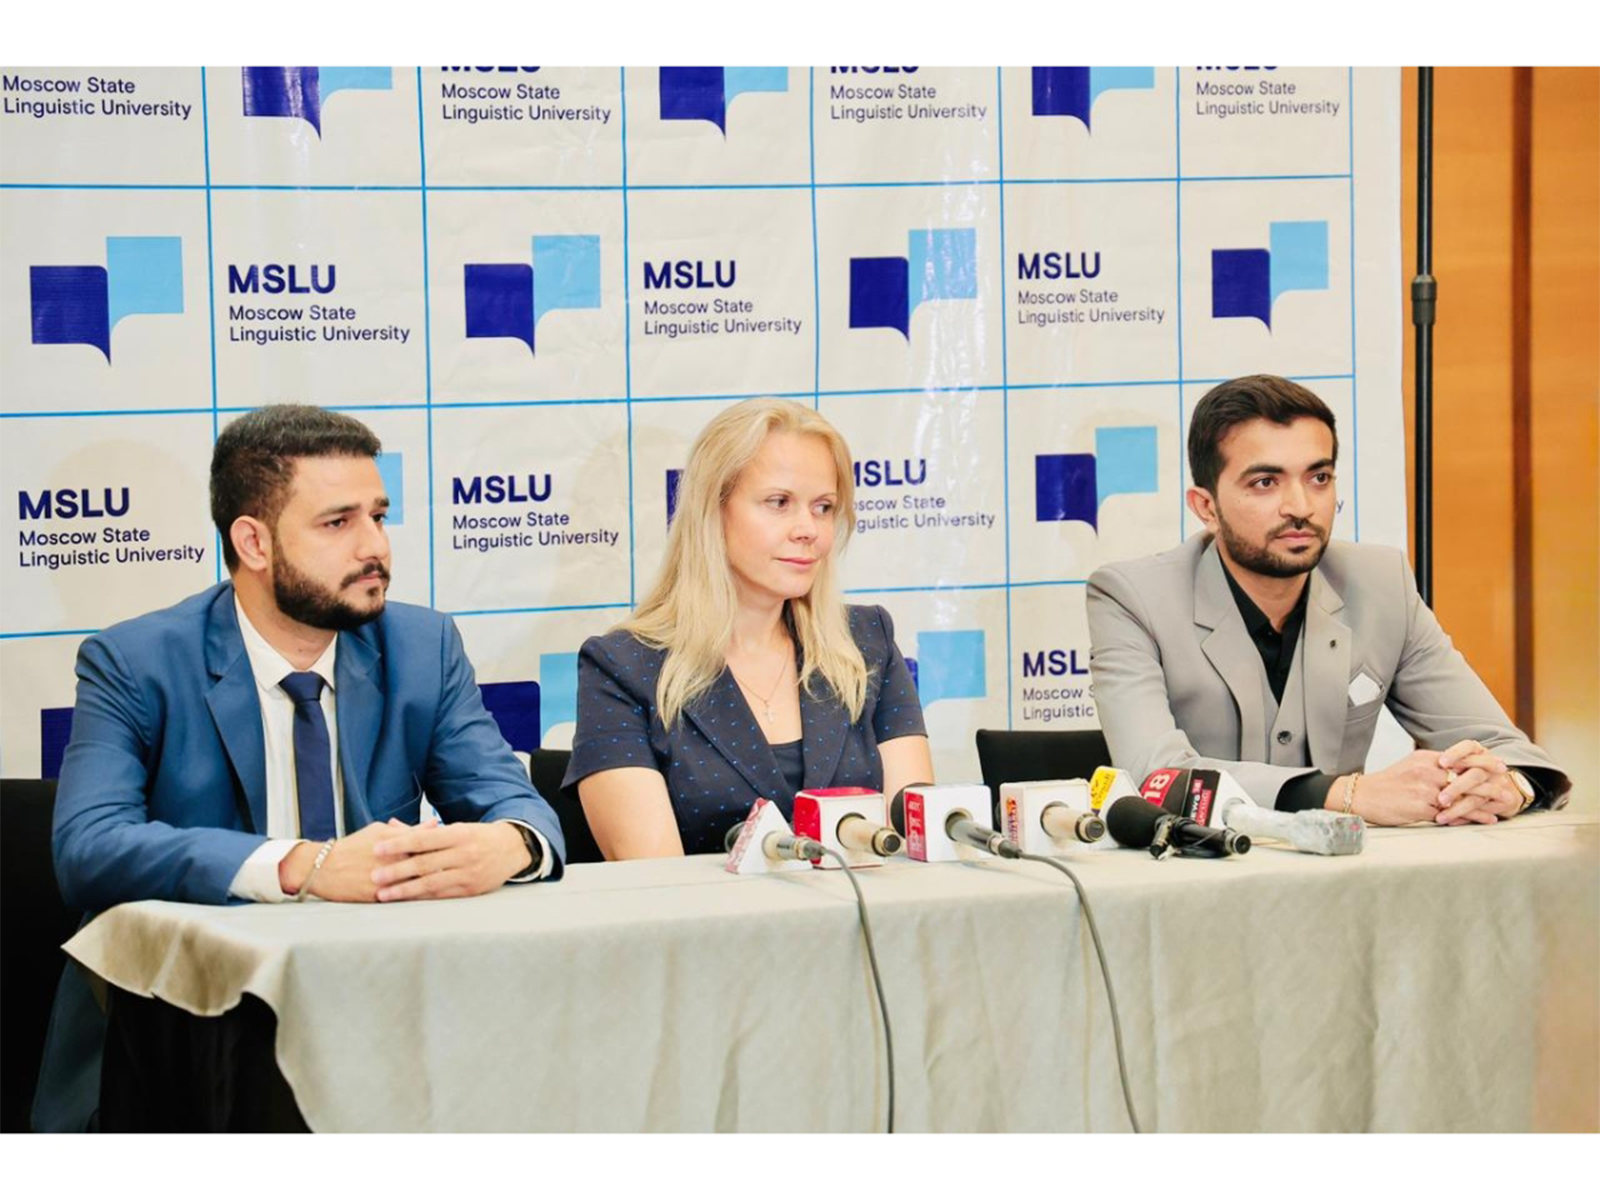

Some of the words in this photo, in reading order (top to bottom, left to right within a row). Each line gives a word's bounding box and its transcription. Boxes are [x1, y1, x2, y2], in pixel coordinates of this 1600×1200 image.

[2, 74, 80, 93] Moscow
[87, 76, 136, 94] State
[441, 83, 511, 99] Moscow
[516, 83, 560, 100] State
[830, 84, 894, 100] Moscow
[898, 84, 937, 99] State
[1196, 81, 1254, 96] Moscow
[1259, 80, 1296, 95] State
[3, 97, 95, 119] Linguistic
[101, 98, 192, 120] University
[442, 104, 524, 124] Linguistic
[529, 104, 611, 124] University
[831, 105, 903, 123] Linguistic
[908, 104, 987, 121] University
[1196, 101, 1264, 119] Linguistic
[1269, 100, 1340, 117] University
[643, 260, 736, 291] MSLU
[1017, 251, 1101, 281] MSLU
[228, 263, 336, 295] MSLU
[1018, 290, 1076, 306] Moscow
[1079, 288, 1119, 304] State
[229, 305, 304, 321] Moscow
[309, 304, 356, 321] State
[644, 300, 709, 316] Moscow
[712, 299, 753, 314] State
[1017, 309, 1085, 328] Linguistic
[1088, 306, 1165, 325] University
[229, 325, 317, 346] Linguistic
[322, 325, 410, 344] University
[644, 319, 720, 339] Linguistic
[723, 317, 802, 336] University
[452, 473, 552, 505] MSLU
[18, 487, 130, 521] MSLU
[853, 500, 898, 512] scow
[902, 495, 945, 510] State
[452, 514, 521, 531] Moscow
[526, 511, 570, 528] State
[856, 514, 909, 534] guistic
[914, 511, 996, 530] University
[19, 530, 97, 546] Moscow
[102, 526, 151, 544] State
[452, 532, 533, 553] Linguistic
[538, 529, 620, 548] University
[19, 548, 110, 571] Linguistic
[115, 545, 205, 565] University
[1023, 649, 1089, 678] MSL
[1023, 687, 1084, 701] Moscow
[1023, 704, 1094, 723] Linguistic
